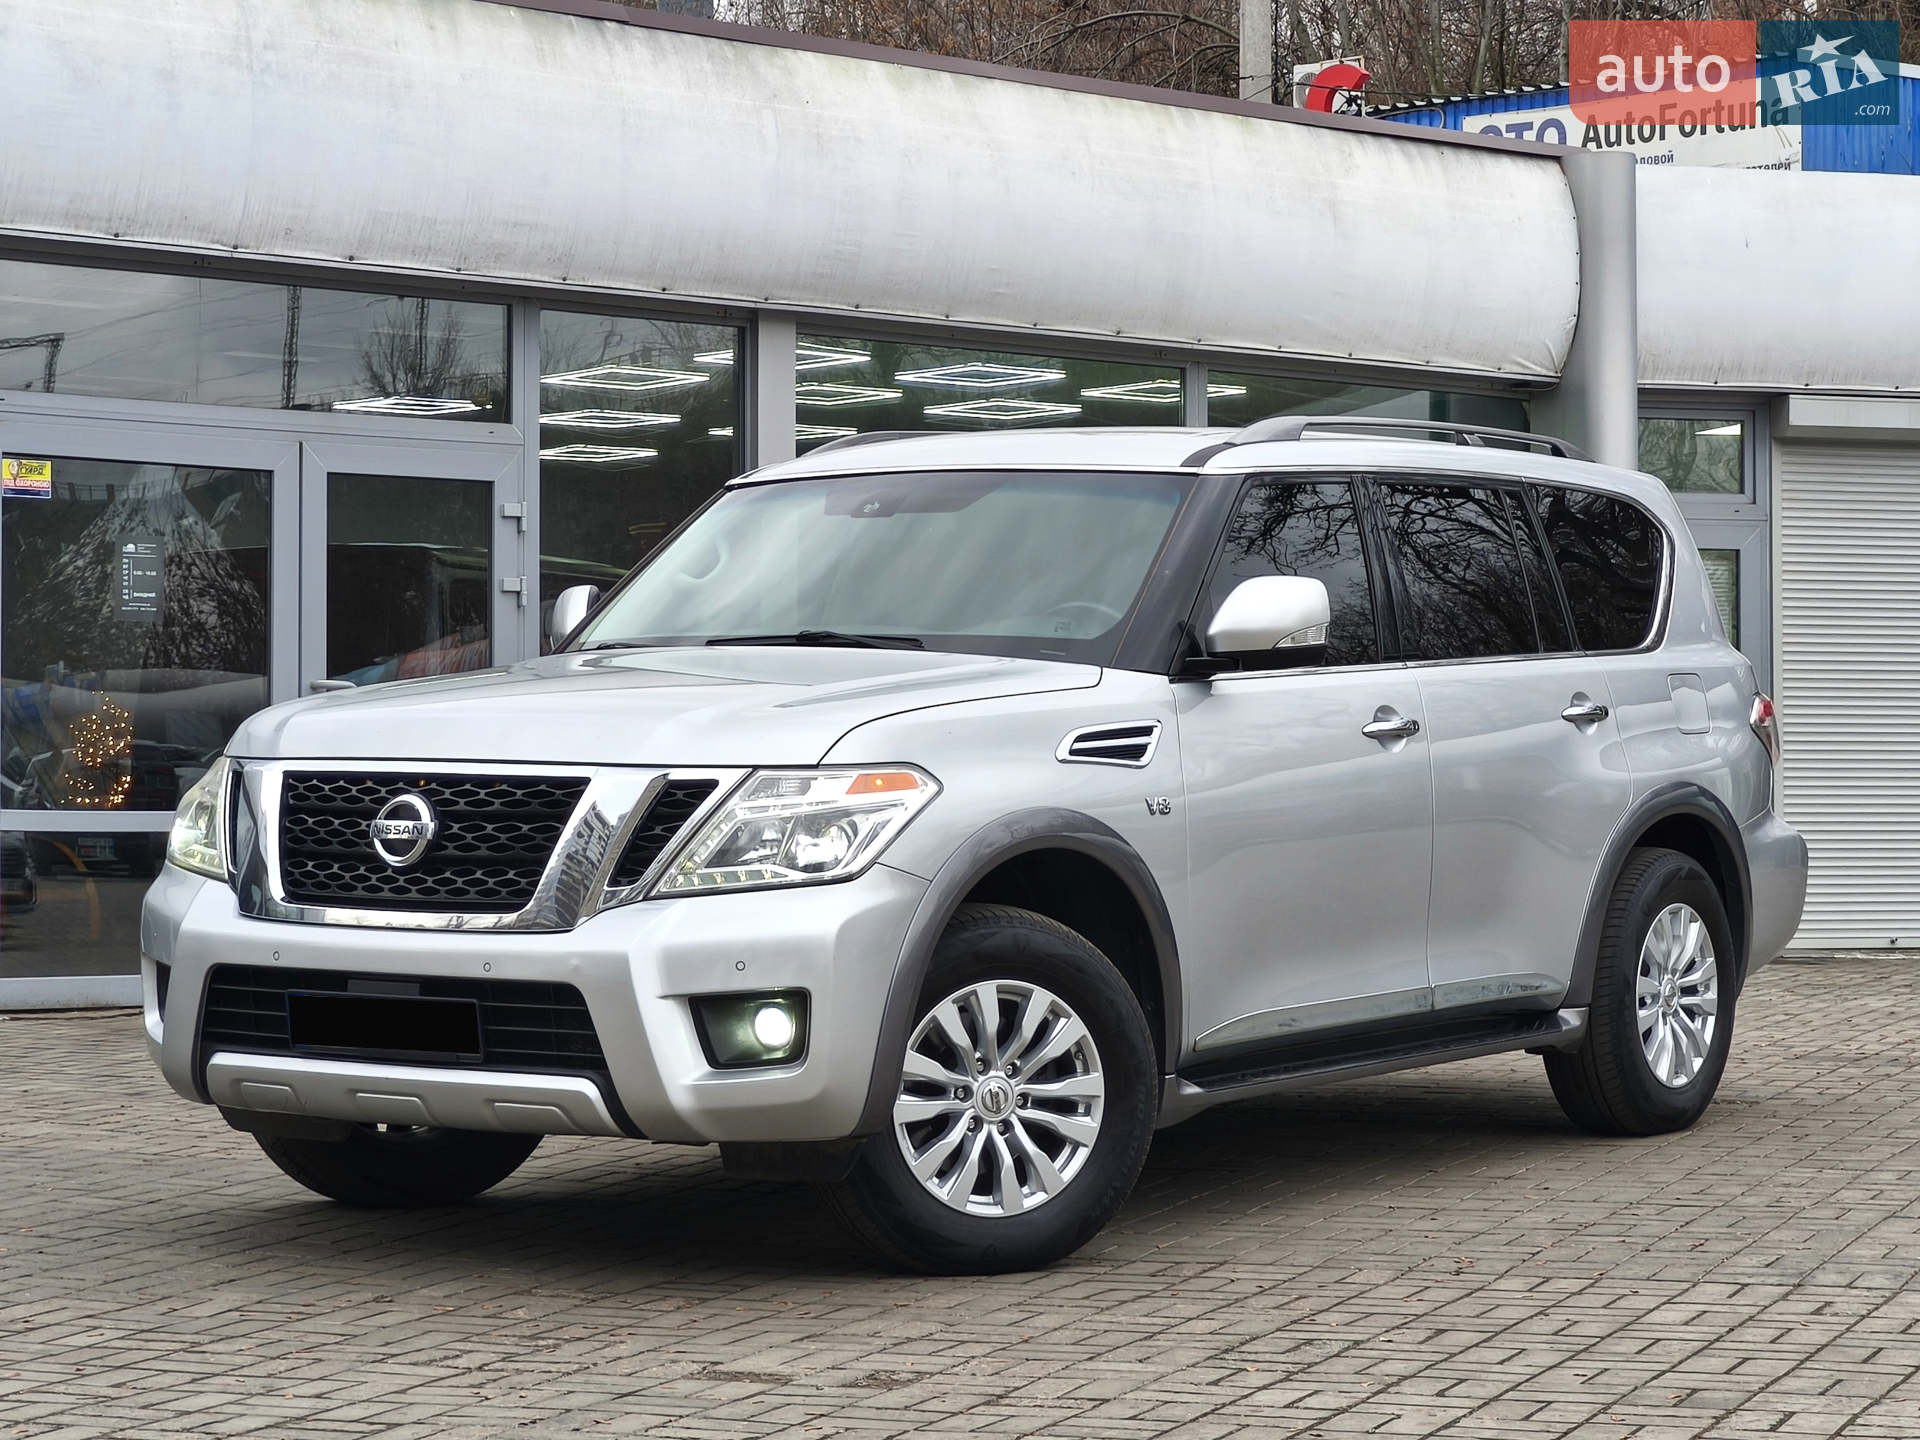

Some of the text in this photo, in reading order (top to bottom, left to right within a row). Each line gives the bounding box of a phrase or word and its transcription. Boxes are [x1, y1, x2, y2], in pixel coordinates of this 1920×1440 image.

[1581, 97, 1790, 150] AutoFortuna
[1144, 796, 1172, 816] V8
[373, 823, 425, 837] NISSAN
